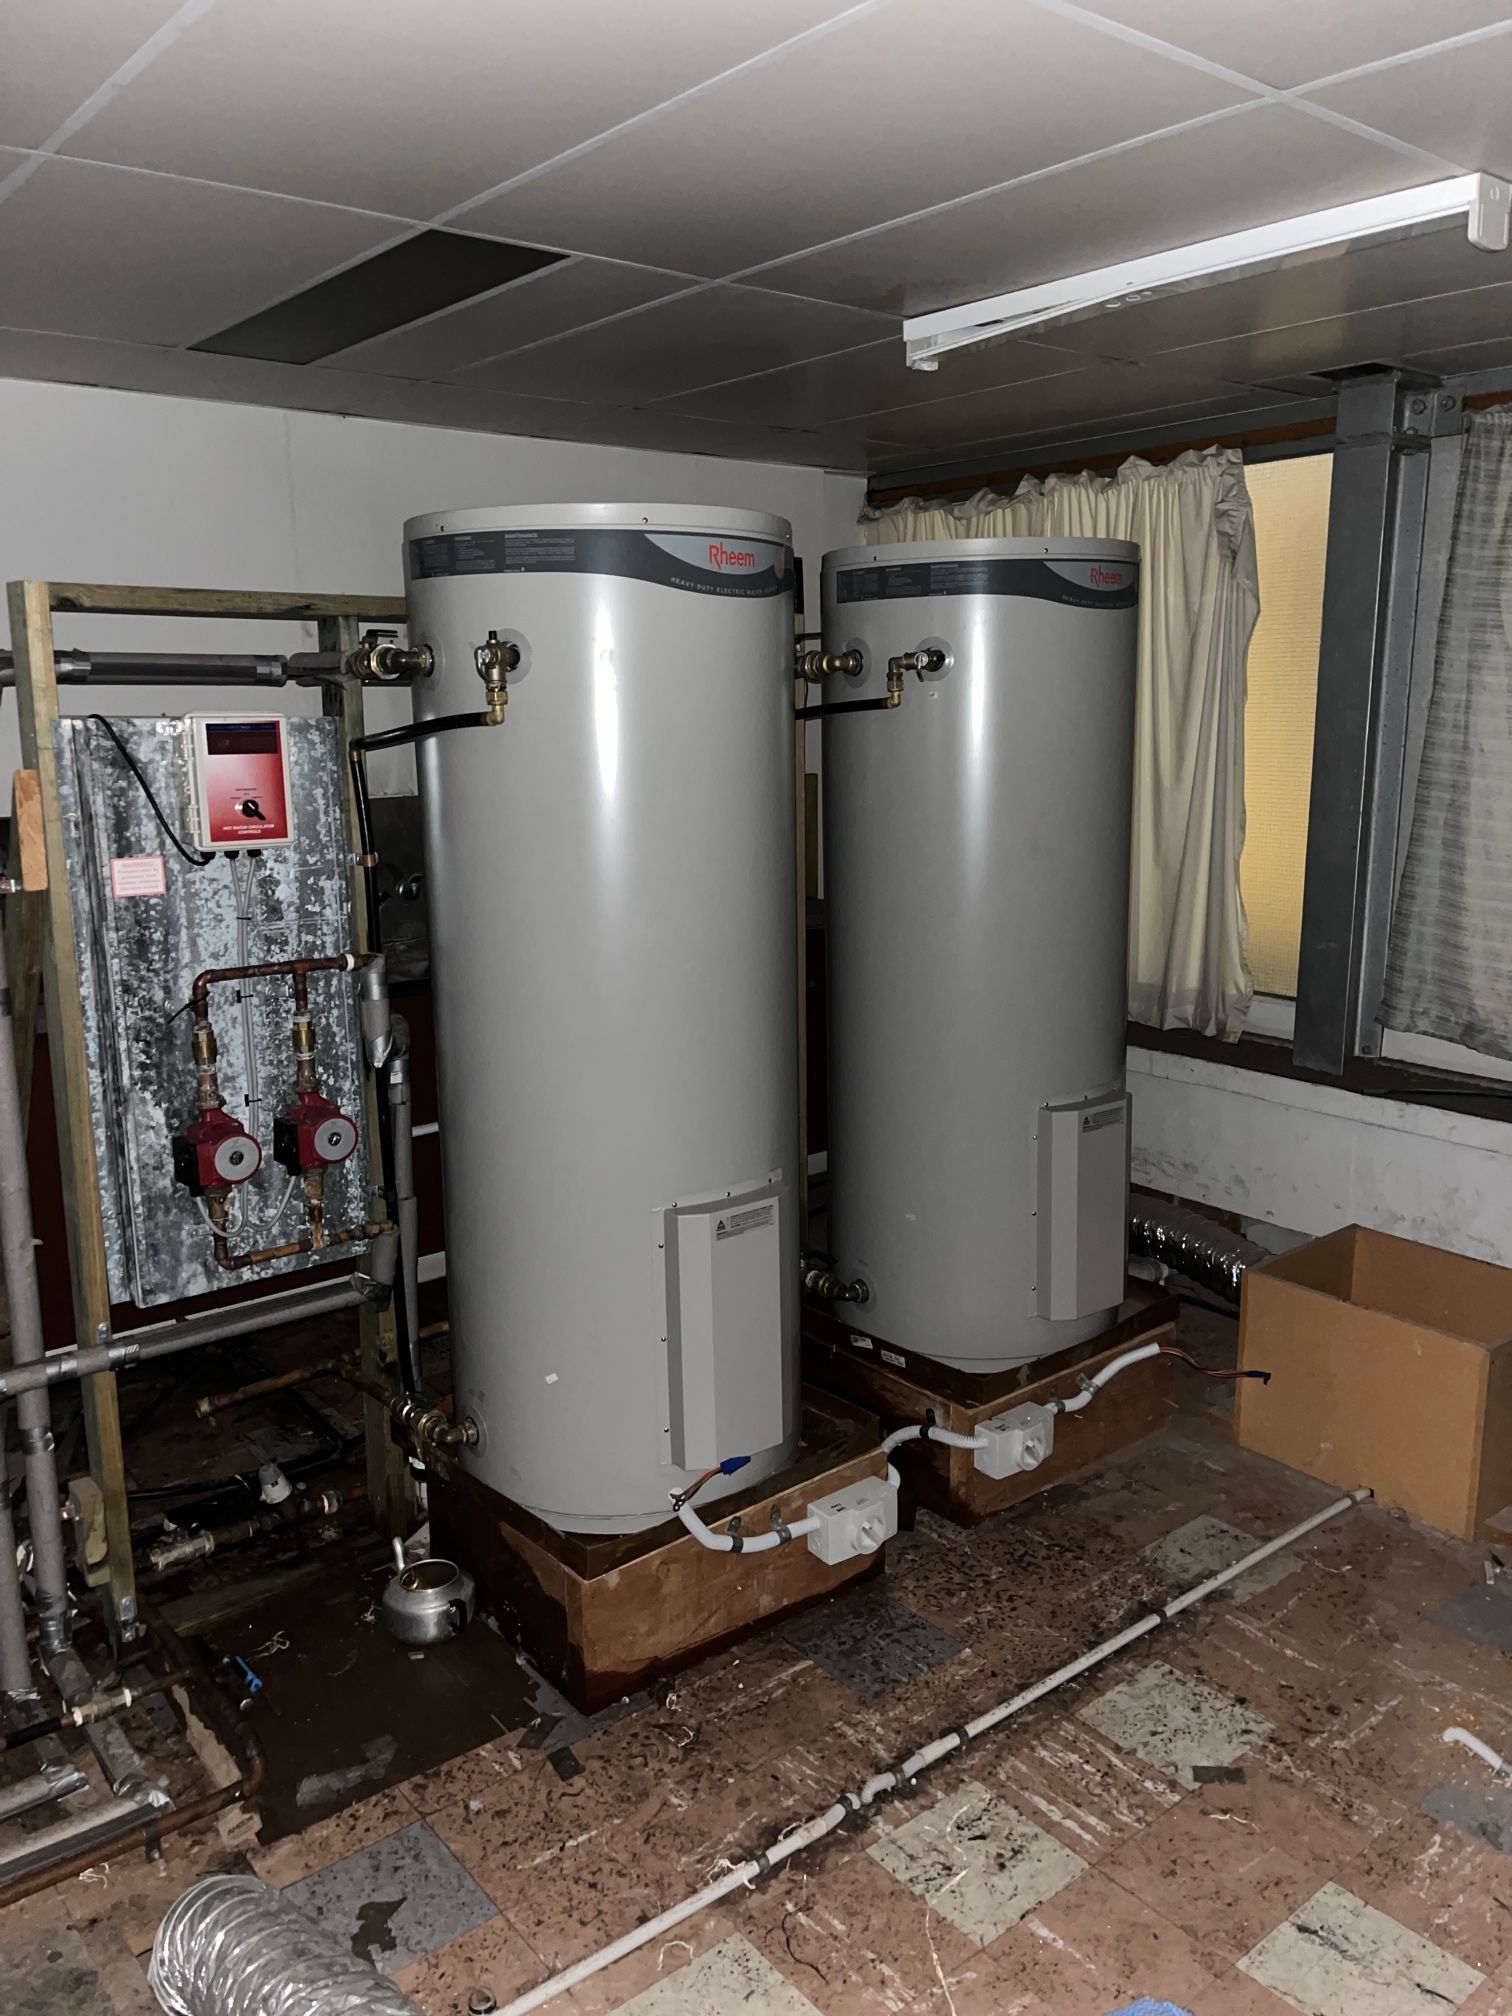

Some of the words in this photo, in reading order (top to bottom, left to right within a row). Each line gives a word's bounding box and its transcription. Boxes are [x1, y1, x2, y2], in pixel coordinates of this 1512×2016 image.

[709, 542, 755, 569] Rheem
[670, 577, 694, 588] HEAVY
[696, 584, 714, 592] DUTY
[1090, 566, 1123, 588] Rheem
